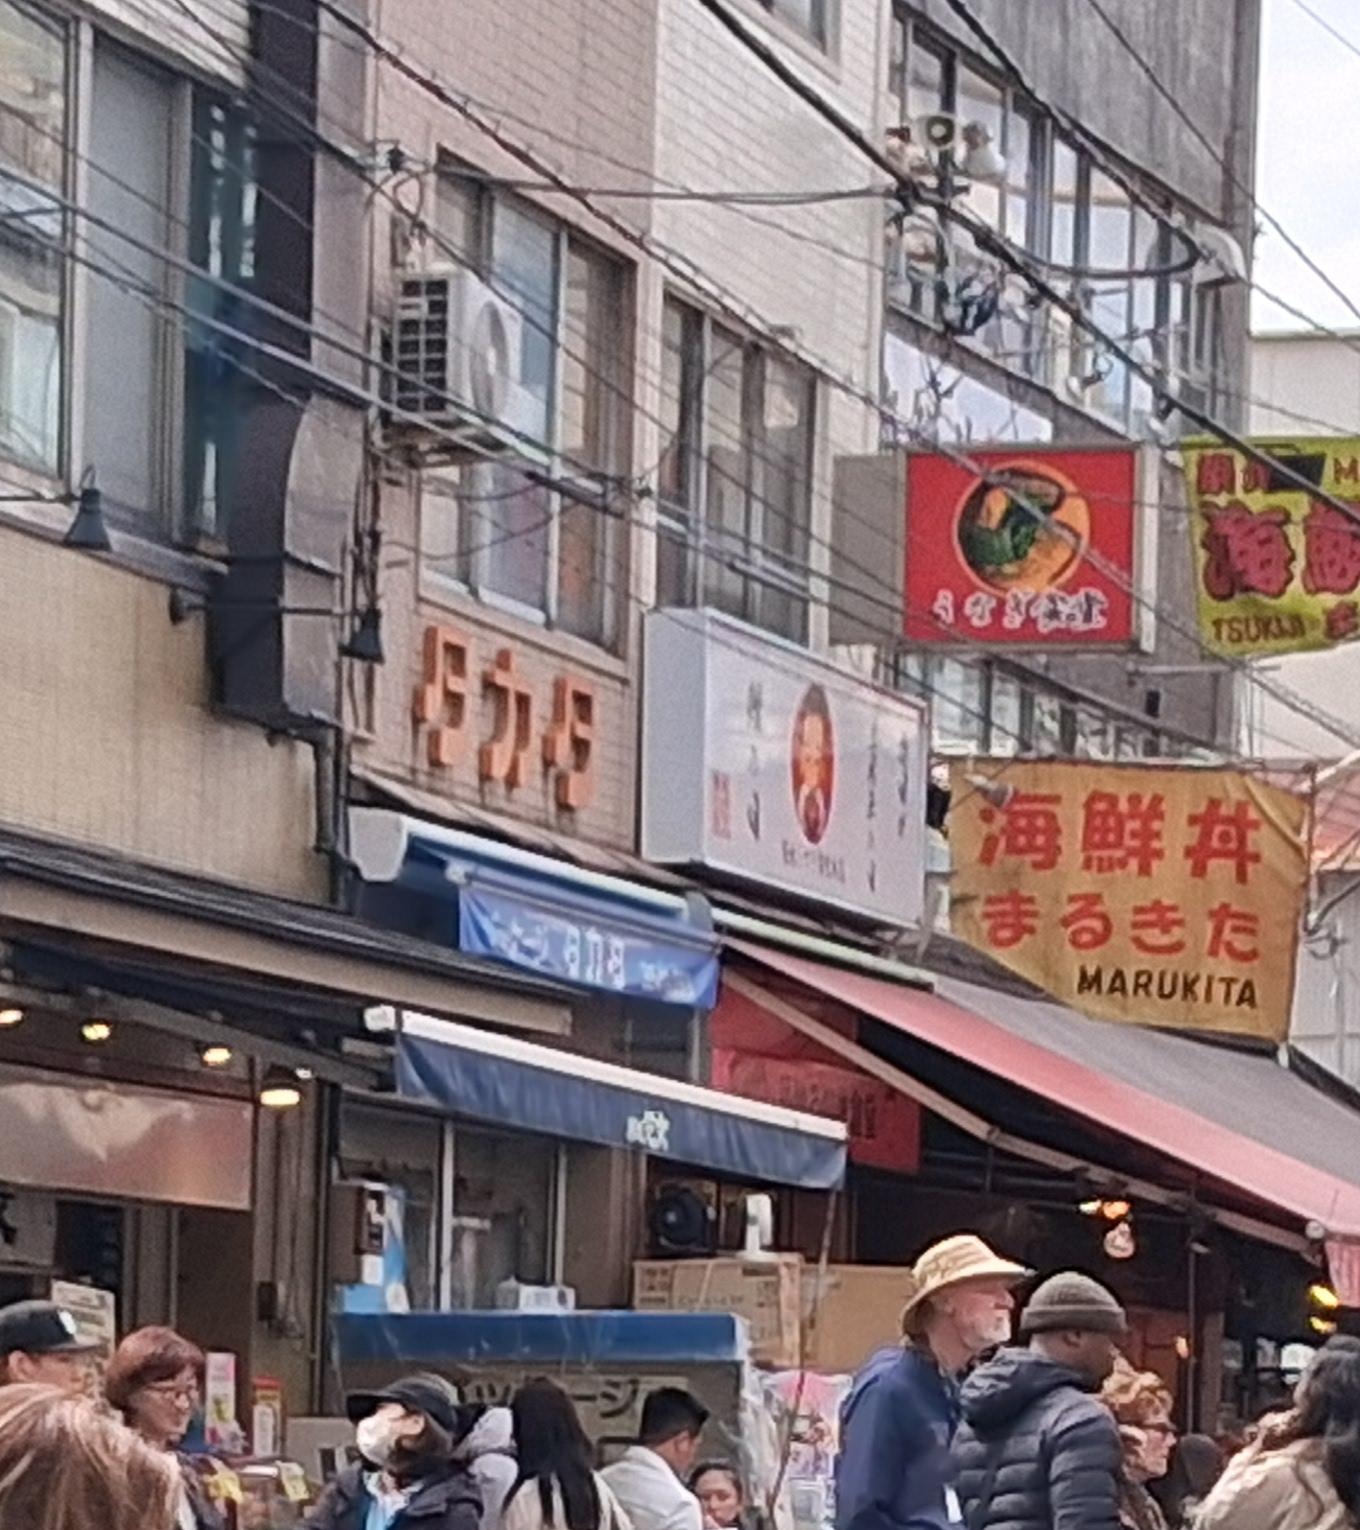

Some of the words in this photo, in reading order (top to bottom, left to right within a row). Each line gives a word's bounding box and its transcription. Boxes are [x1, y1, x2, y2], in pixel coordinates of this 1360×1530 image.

[979, 788, 1262, 884] 海鮮丼
[982, 891, 1261, 964] まるきた
[1077, 964, 1258, 1010] MARUKITA
